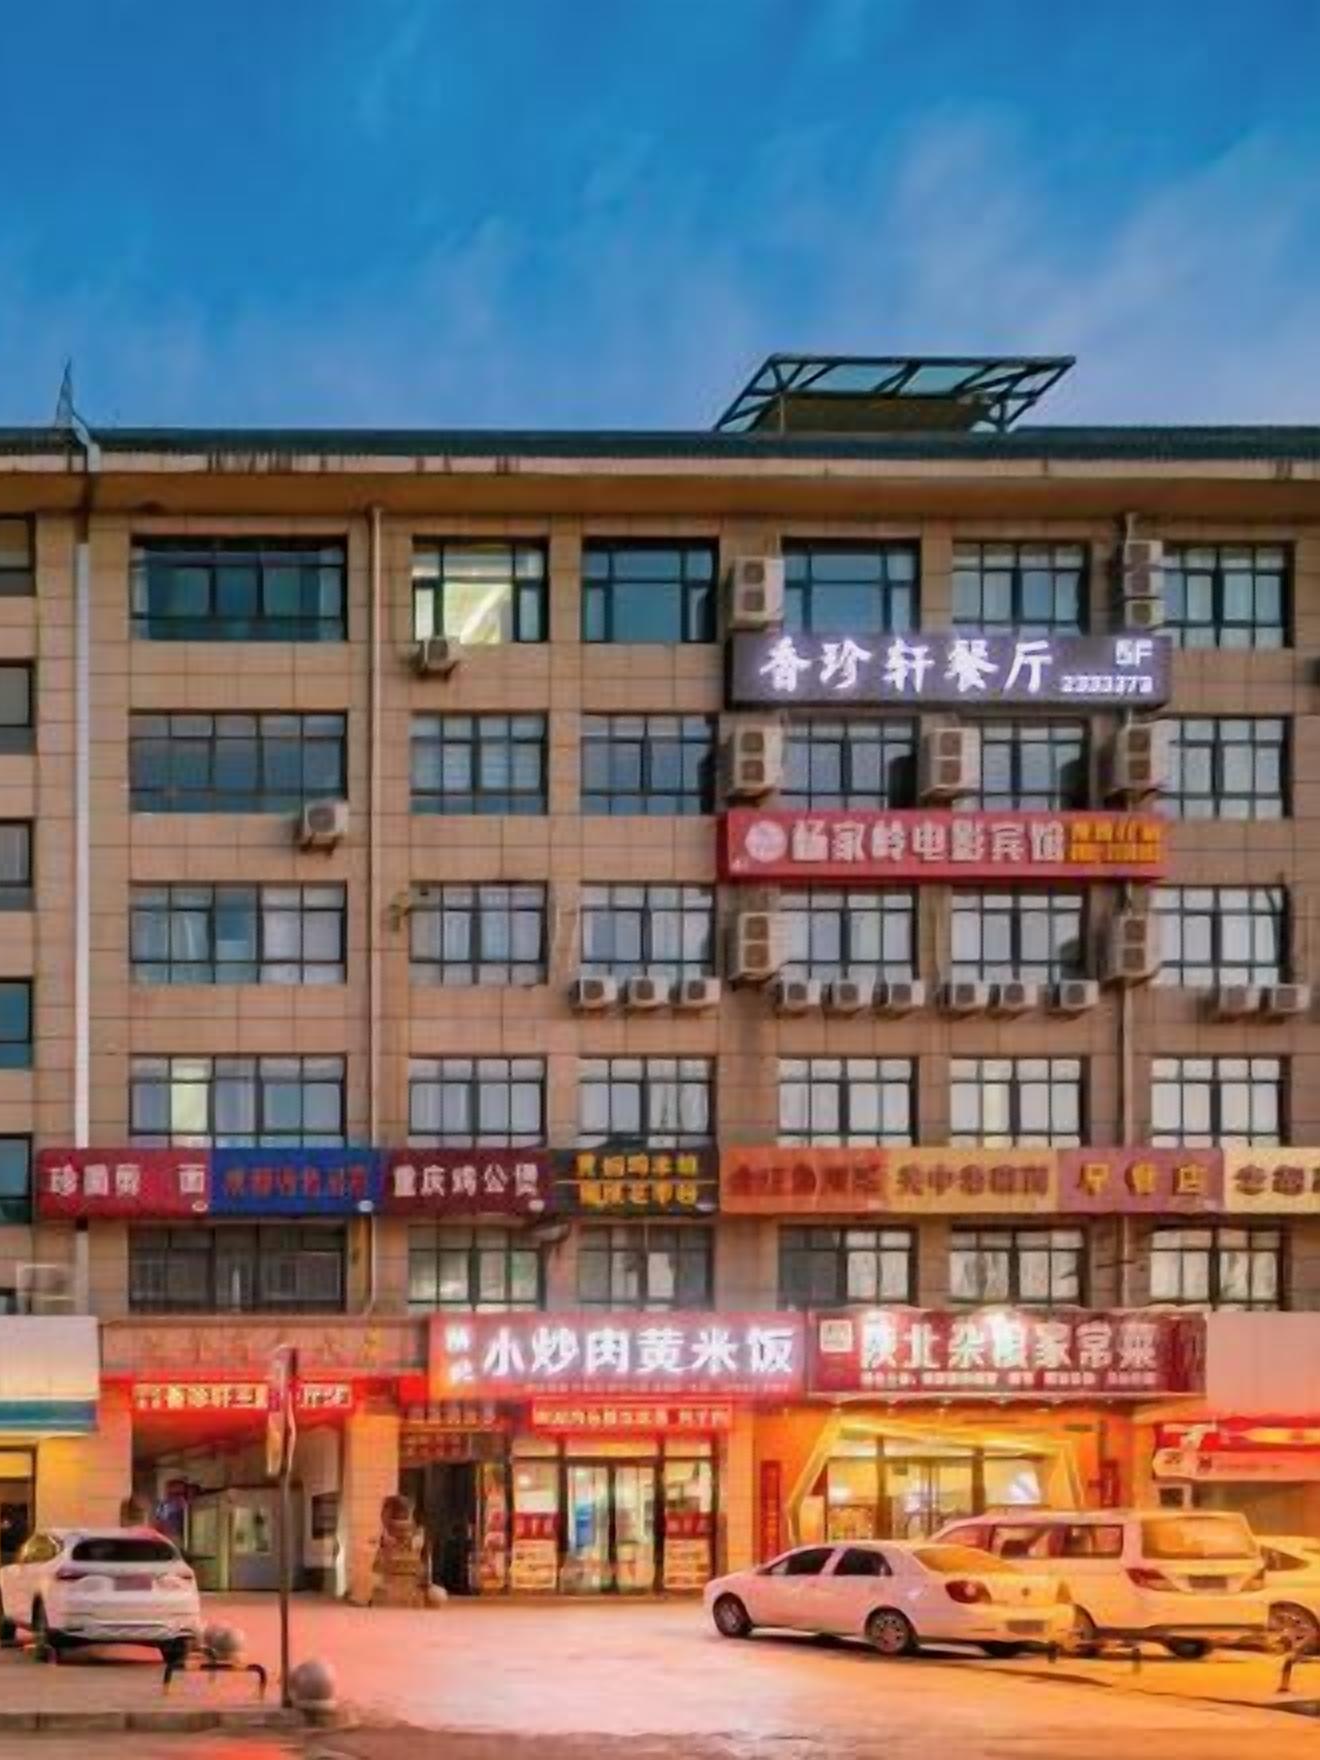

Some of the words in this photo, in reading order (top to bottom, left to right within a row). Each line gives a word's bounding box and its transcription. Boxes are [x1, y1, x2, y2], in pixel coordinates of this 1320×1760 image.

[759, 636, 1053, 694] 香珍轩餐厅
[482, 1324, 797, 1377] 小炒肉黄米饭
